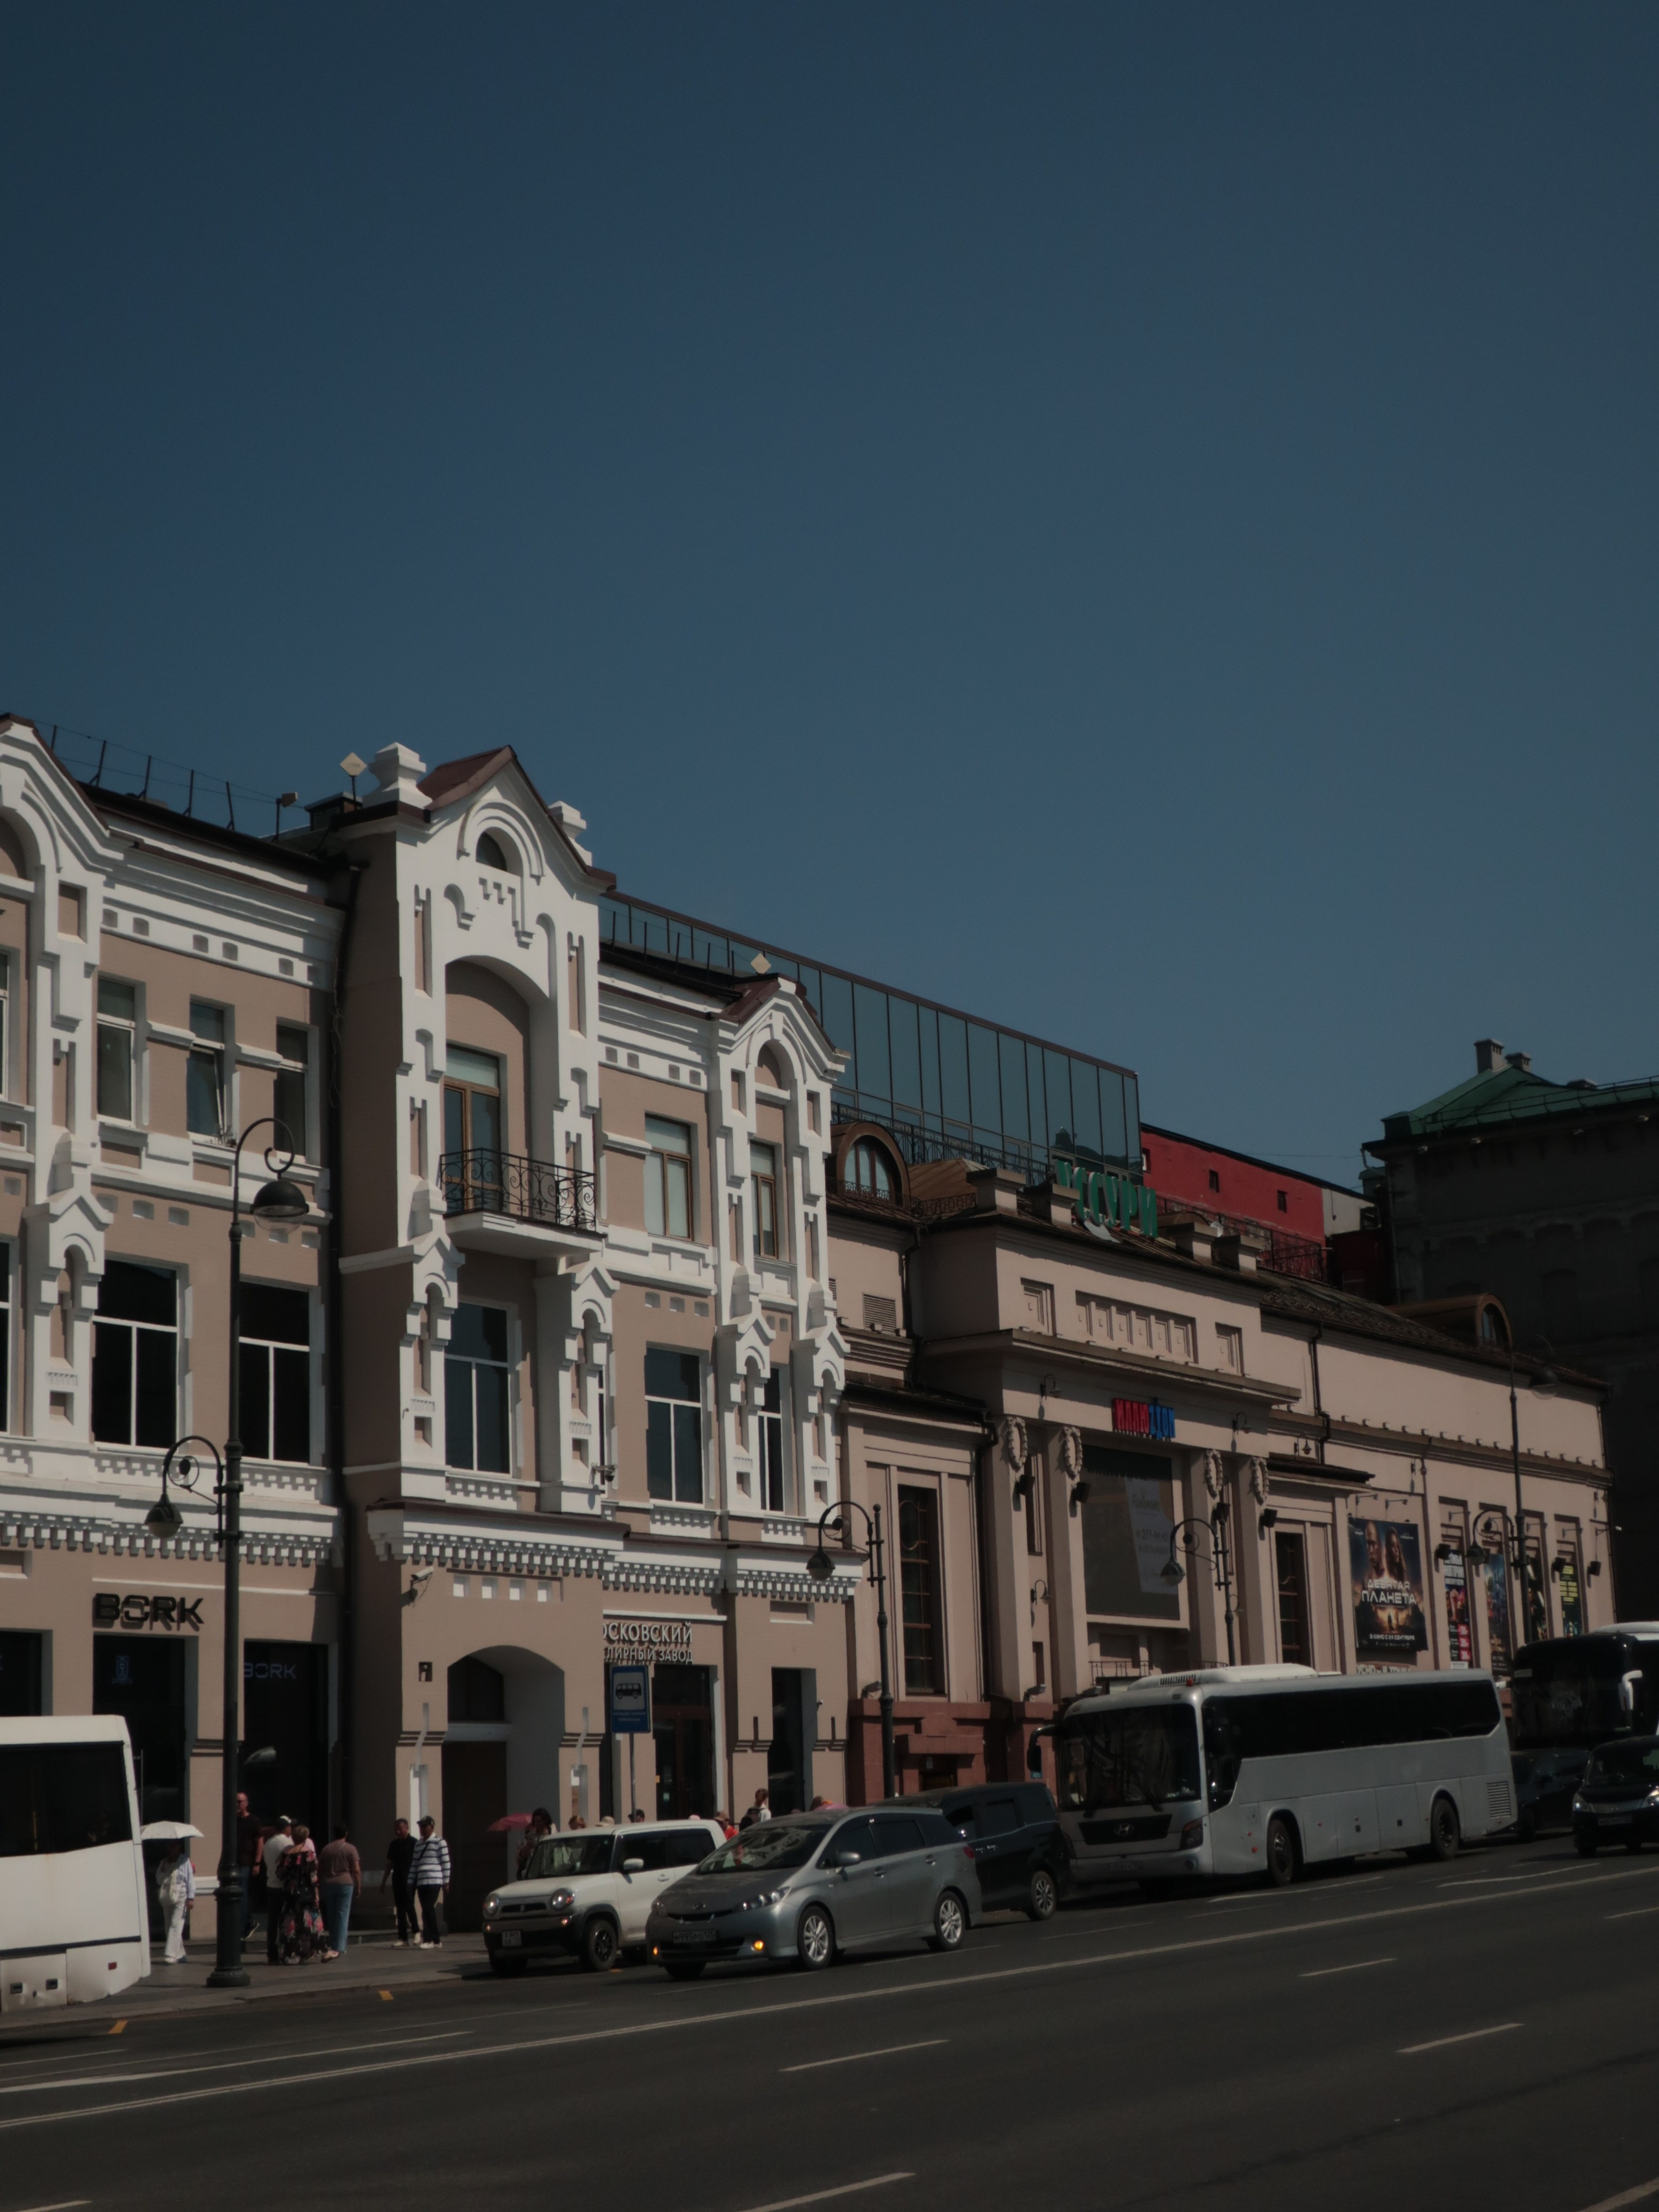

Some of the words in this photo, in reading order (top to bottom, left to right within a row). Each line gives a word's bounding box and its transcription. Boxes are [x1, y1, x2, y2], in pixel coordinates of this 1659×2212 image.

[1367, 1579, 1410, 1590] ДЕВЯТАЯ
[1362, 1590, 1417, 1605] ПЛАНЕТА
[95, 1593, 204, 1624] BORK
[604, 1645, 655, 1660] ЛИРНЫЙ
[659, 1649, 693, 1666] ЗАВОД
[244, 1662, 296, 1679] BORK
